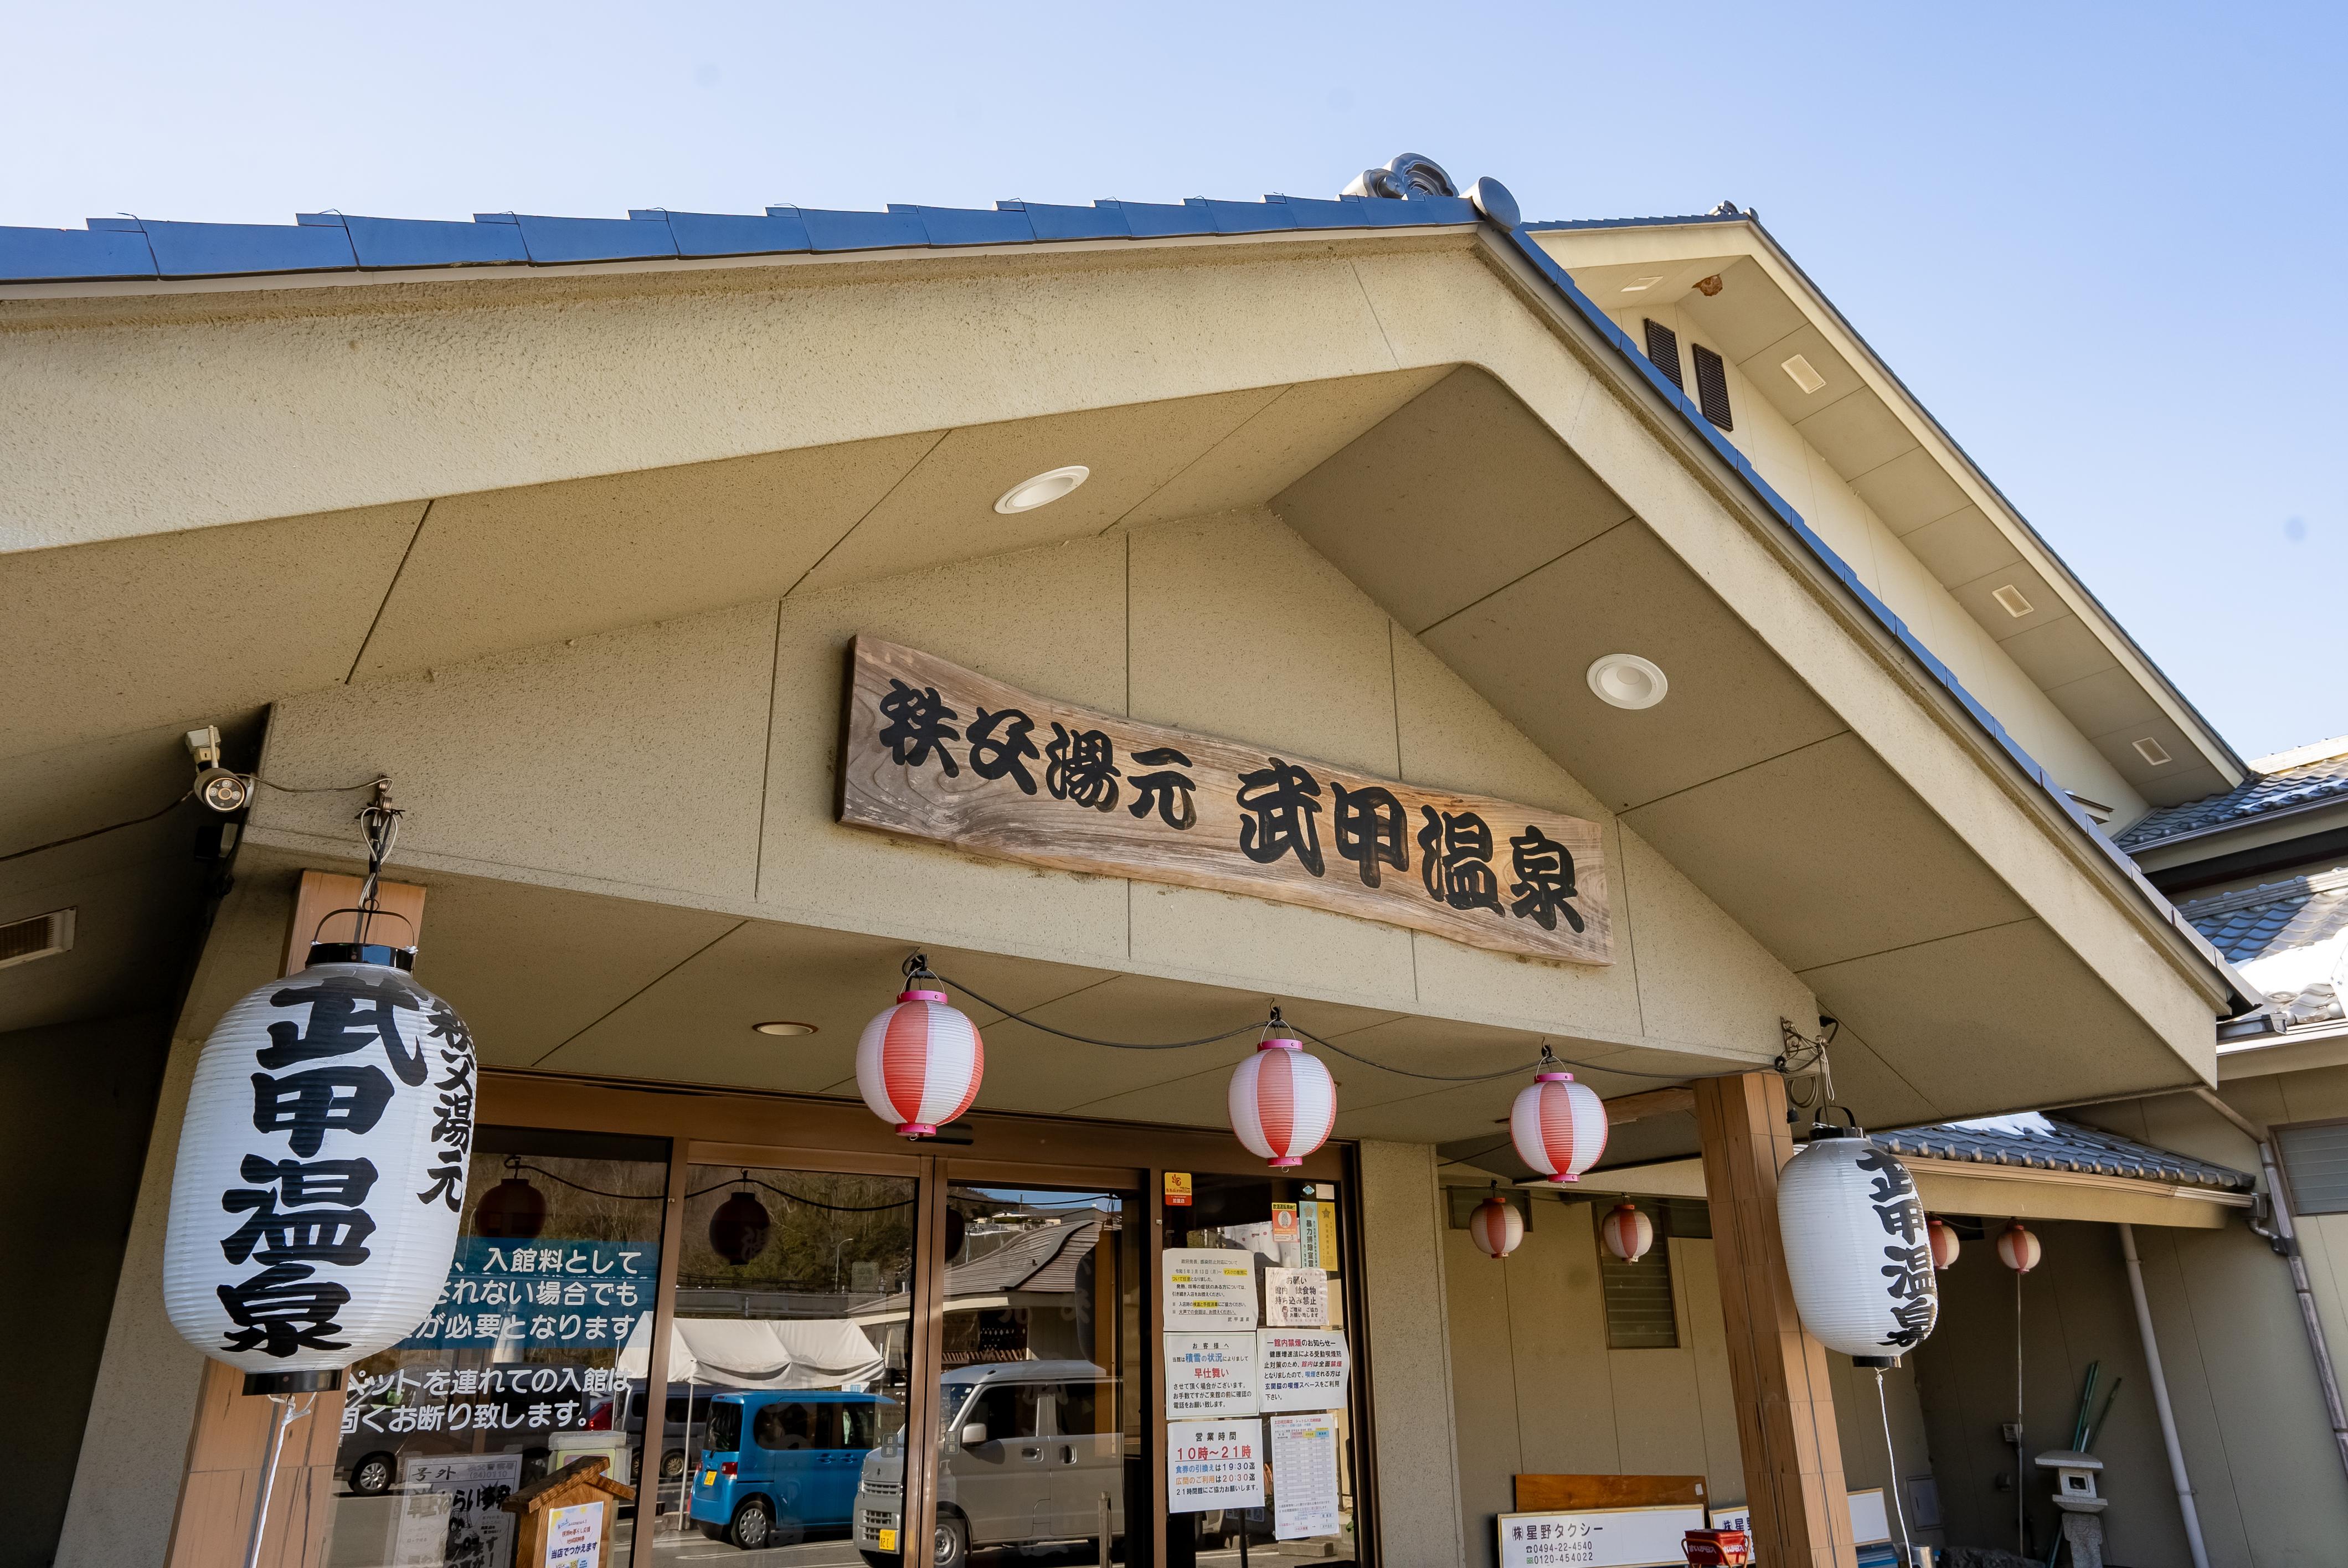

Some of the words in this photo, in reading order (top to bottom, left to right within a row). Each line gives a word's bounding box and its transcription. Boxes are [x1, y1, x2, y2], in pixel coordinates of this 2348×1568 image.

[880, 679, 1196, 831] 秩父湯元
[1238, 757, 1585, 933] 武甲温泉
[417, 998, 477, 1212] 秩父湯元
[217, 976, 429, 1358] 武甲温泉
[1856, 1149, 1937, 1347] 武甲温泉
[1286, 1276, 1306, 1285] お願い
[1275, 1286, 1288, 1294] 館内
[1295, 1286, 1316, 1295] 飲食物
[1275, 1296, 1316, 1305] 持ち込み禁止
[406, 1312, 635, 1340] が必要となります
[1194, 1368, 1229, 1379] 早仕舞い
[350, 1367, 632, 1396] ペットを連れての入館は
[1173, 1391, 1252, 1399] お手数ですがご来館の前に確認の
[949, 1433, 955, 1452] 自動
[1196, 1432, 1237, 1441] 営業時間
[886, 1436, 893, 1454] 自動
[1178, 1445, 1251, 1460] 10時～21時
[411, 1466, 456, 1482] 号外
[1176, 1462, 1255, 1474] 食券の引換えは19:30迄
[1176, 1473, 1255, 1485] 広間のご利用は20:30迄
[1177, 1484, 1258, 1495] 21時閉館にご協力お願いします。
[551, 1541, 598, 1559] 当店でつかえます
[1533, 1541, 1592, 1553] 0494-22-4540
[1534, 1552, 1593, 1564] 0120-454022
